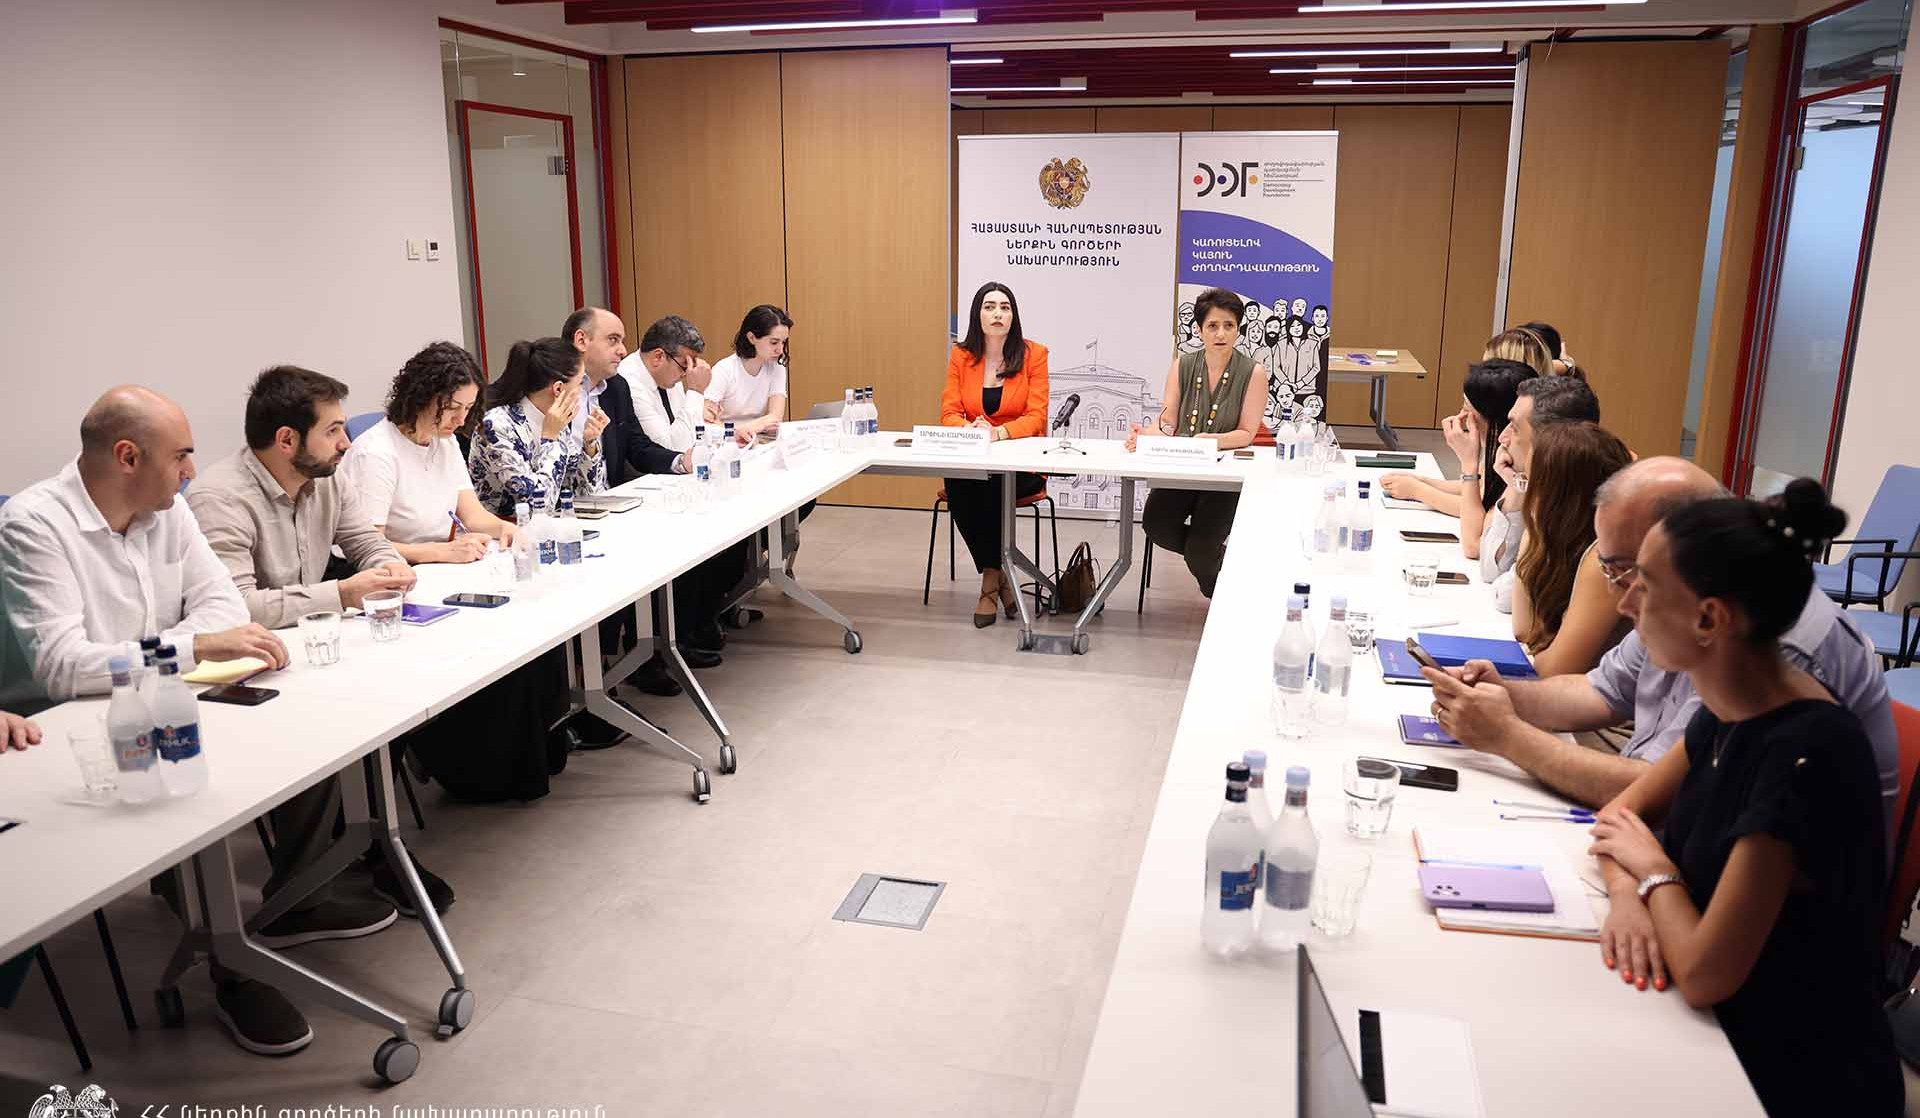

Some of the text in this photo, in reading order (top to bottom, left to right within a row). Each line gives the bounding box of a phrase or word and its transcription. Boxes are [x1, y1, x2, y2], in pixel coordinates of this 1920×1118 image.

[971, 222, 1162, 235] ՀԱՅԱՍՏԱՆԻ ՀԱՆՐԱՊԵՏՈՒԹՅԱՆ
[1006, 239, 1122, 250] ՆԵՐՔԻՆ ԳՈՐԾԵՐԻ
[1192, 238, 1261, 247] ԿԱՌՈՒՑԵԼՈՎ
[1192, 250, 1233, 259] ԿԱՅՈՒՆ
[1007, 254, 1120, 267] ՆԱԽԱՐԱՐՈՒԹՅՈՒՆ
[1191, 263, 1320, 272] ԺՈՂՈՎՐԴԱՎԱՐՈՒԹՅՈՒՆ
